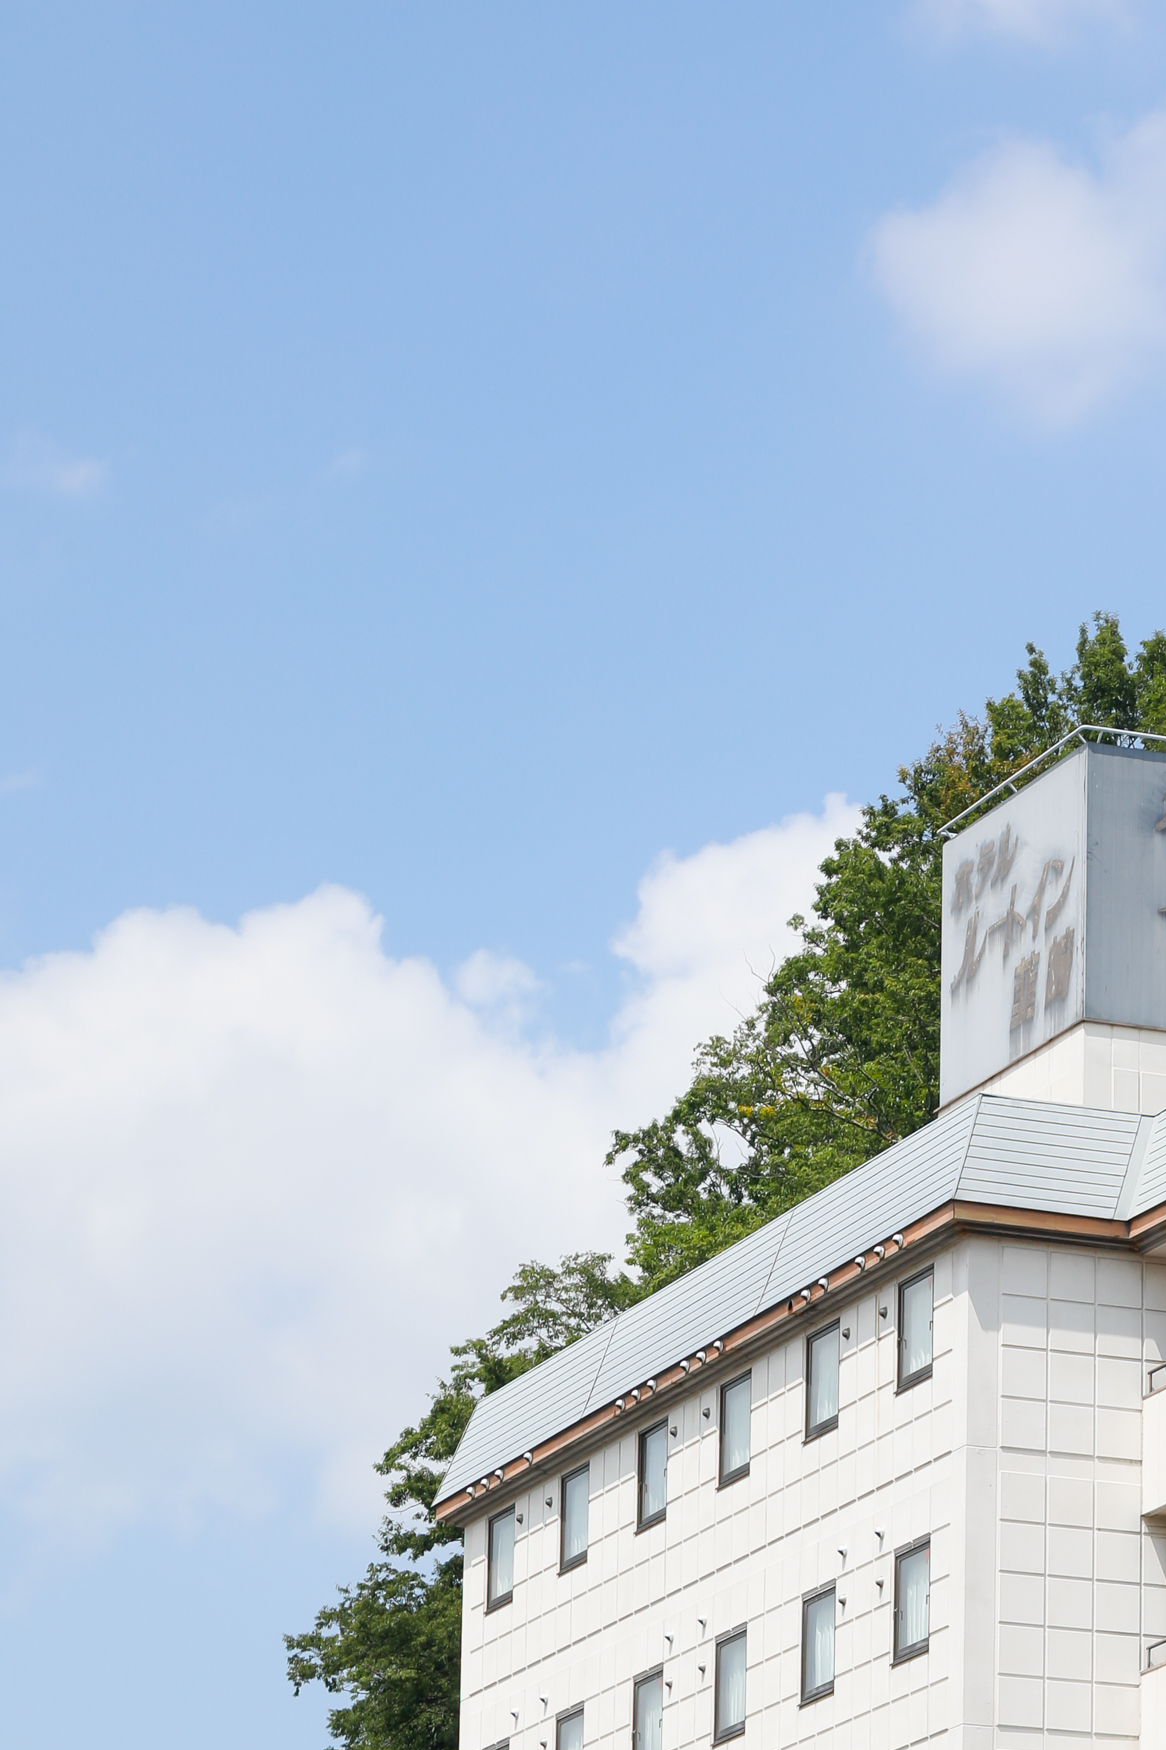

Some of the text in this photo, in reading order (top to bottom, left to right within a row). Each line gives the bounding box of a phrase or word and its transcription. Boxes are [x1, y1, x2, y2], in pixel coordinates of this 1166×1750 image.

[950, 854, 1075, 993] ルートイン
[951, 824, 1019, 912] ホテル
